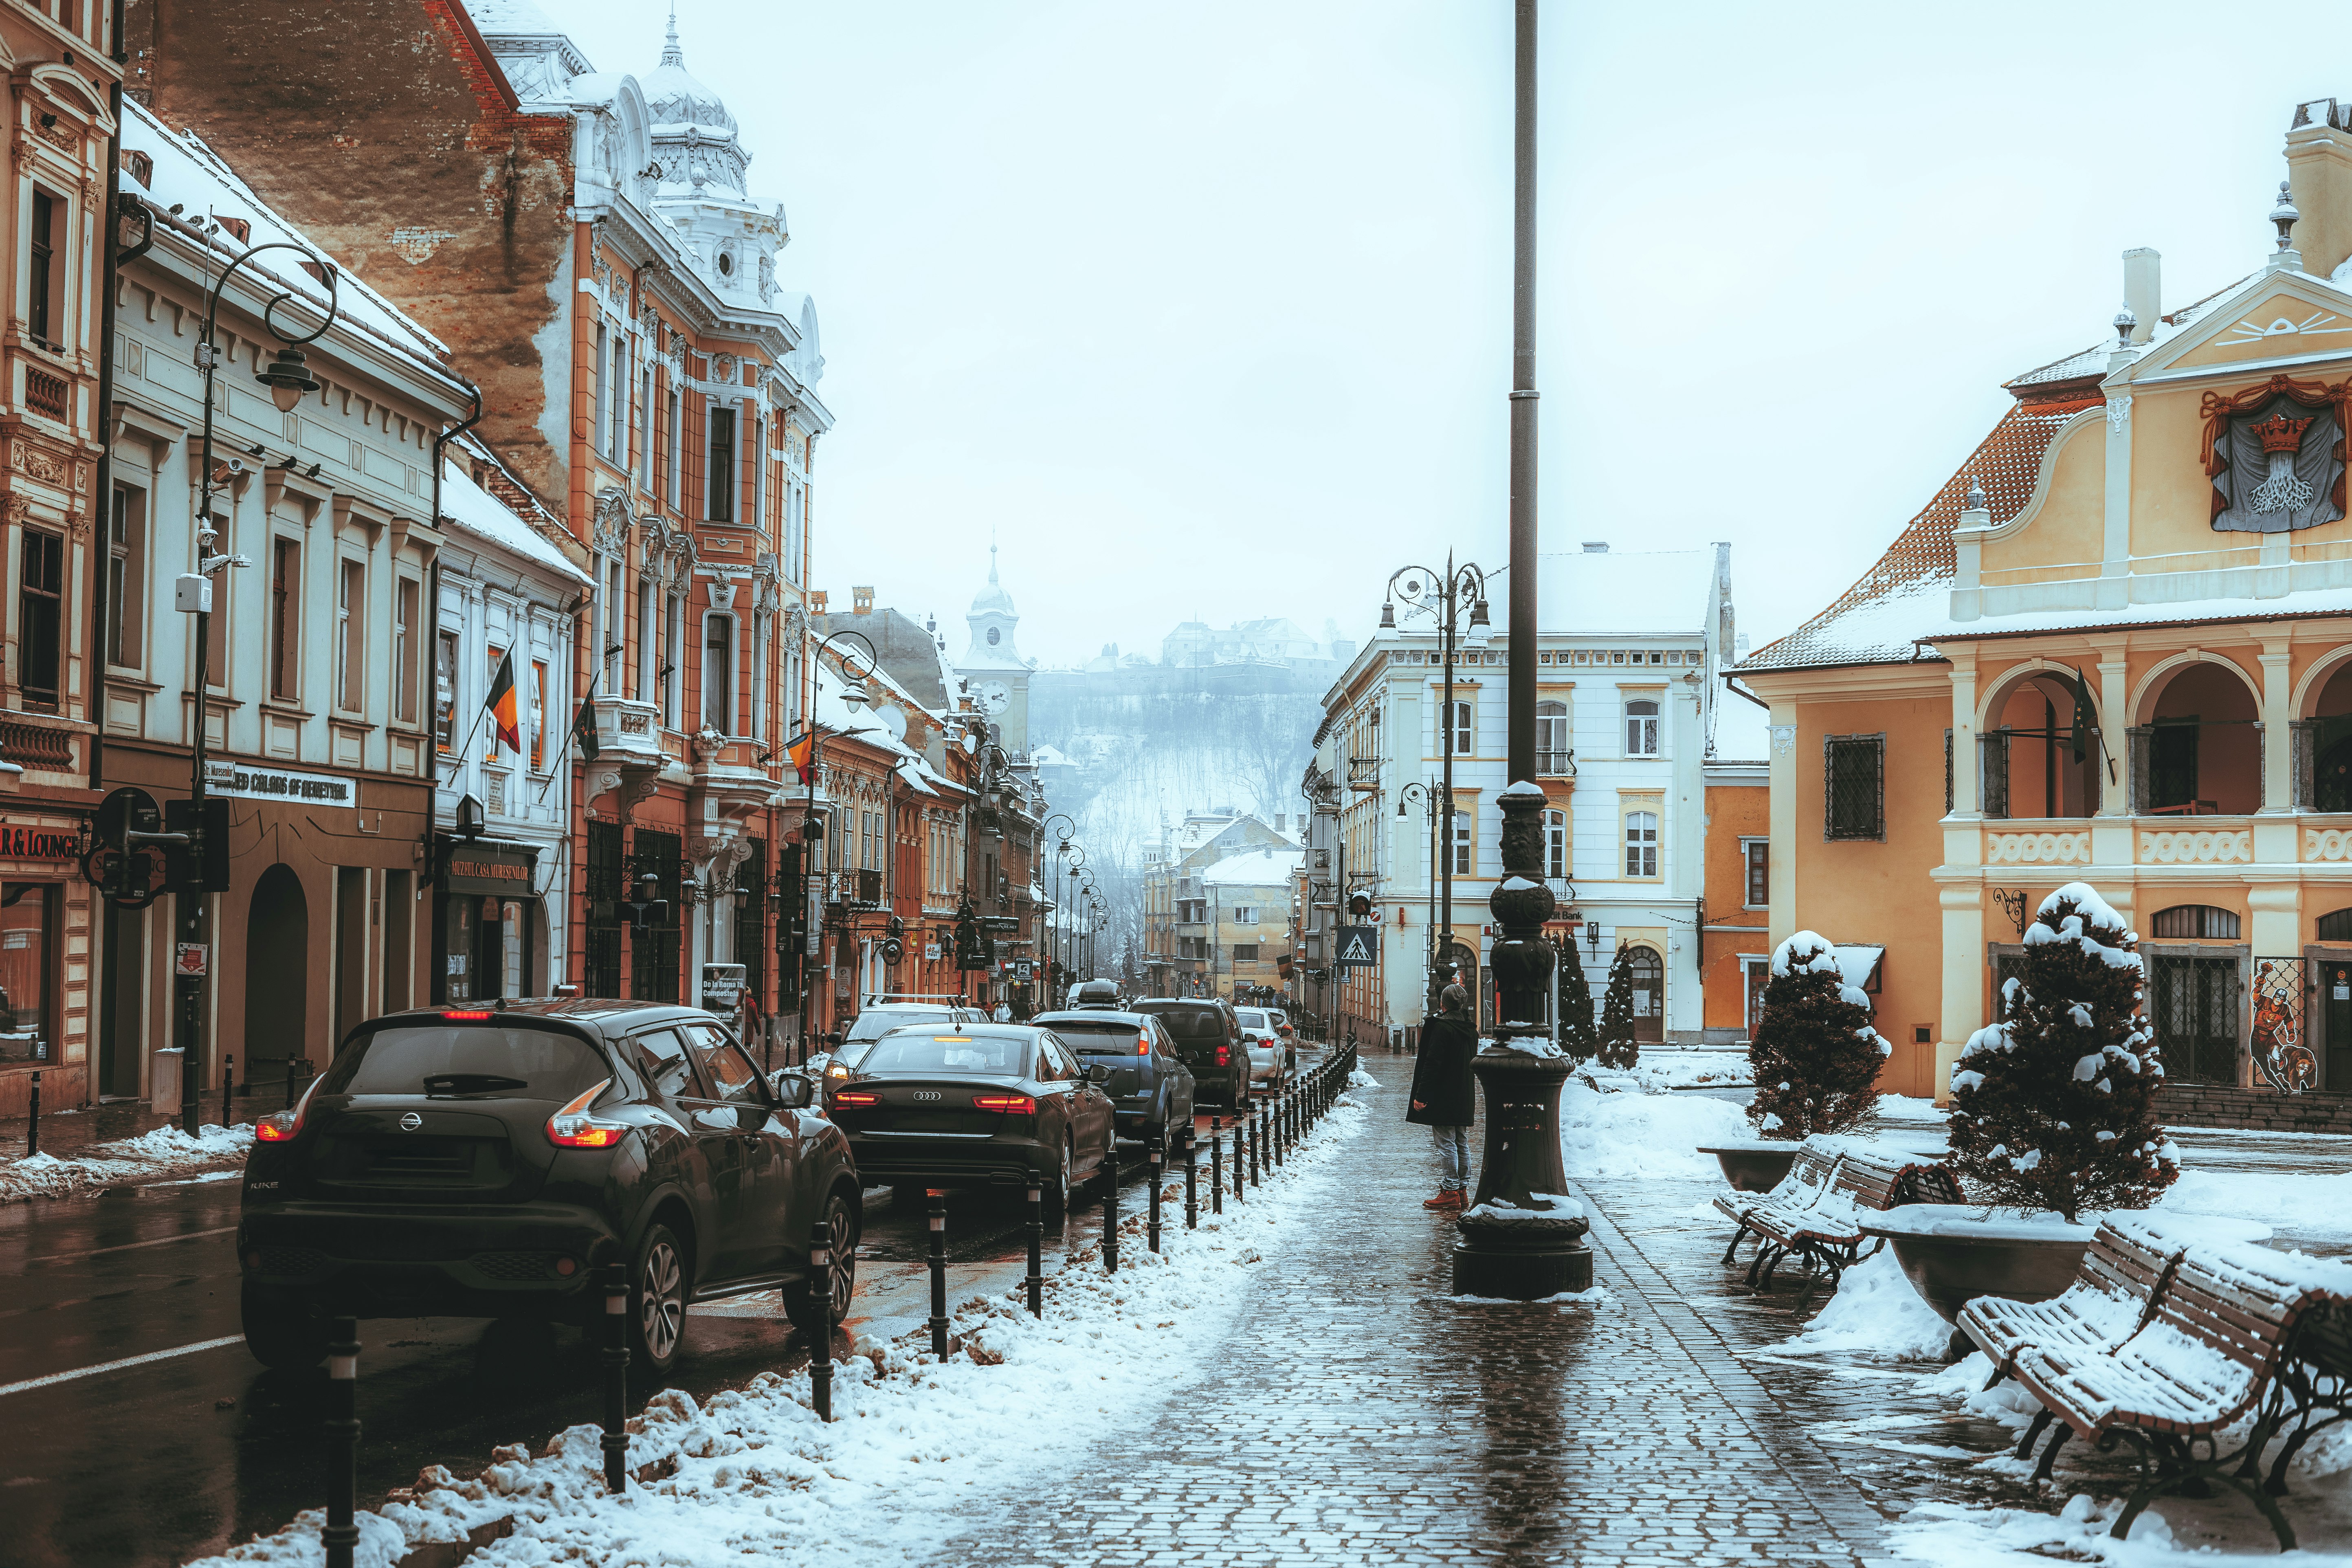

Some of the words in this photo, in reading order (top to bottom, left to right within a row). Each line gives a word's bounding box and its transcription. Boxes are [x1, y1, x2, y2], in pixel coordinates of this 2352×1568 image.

[251, 773, 287, 794] COLORS
[289, 779, 301, 795] OF
[13, 829, 26, 855] &
[27, 830, 78, 858] LOUNGE
[452, 860, 475, 876] MUZEUL
[476, 863, 489, 877] CASA
[1562, 911, 1583, 920] Bank
[248, 1182, 279, 1192] JUKE
